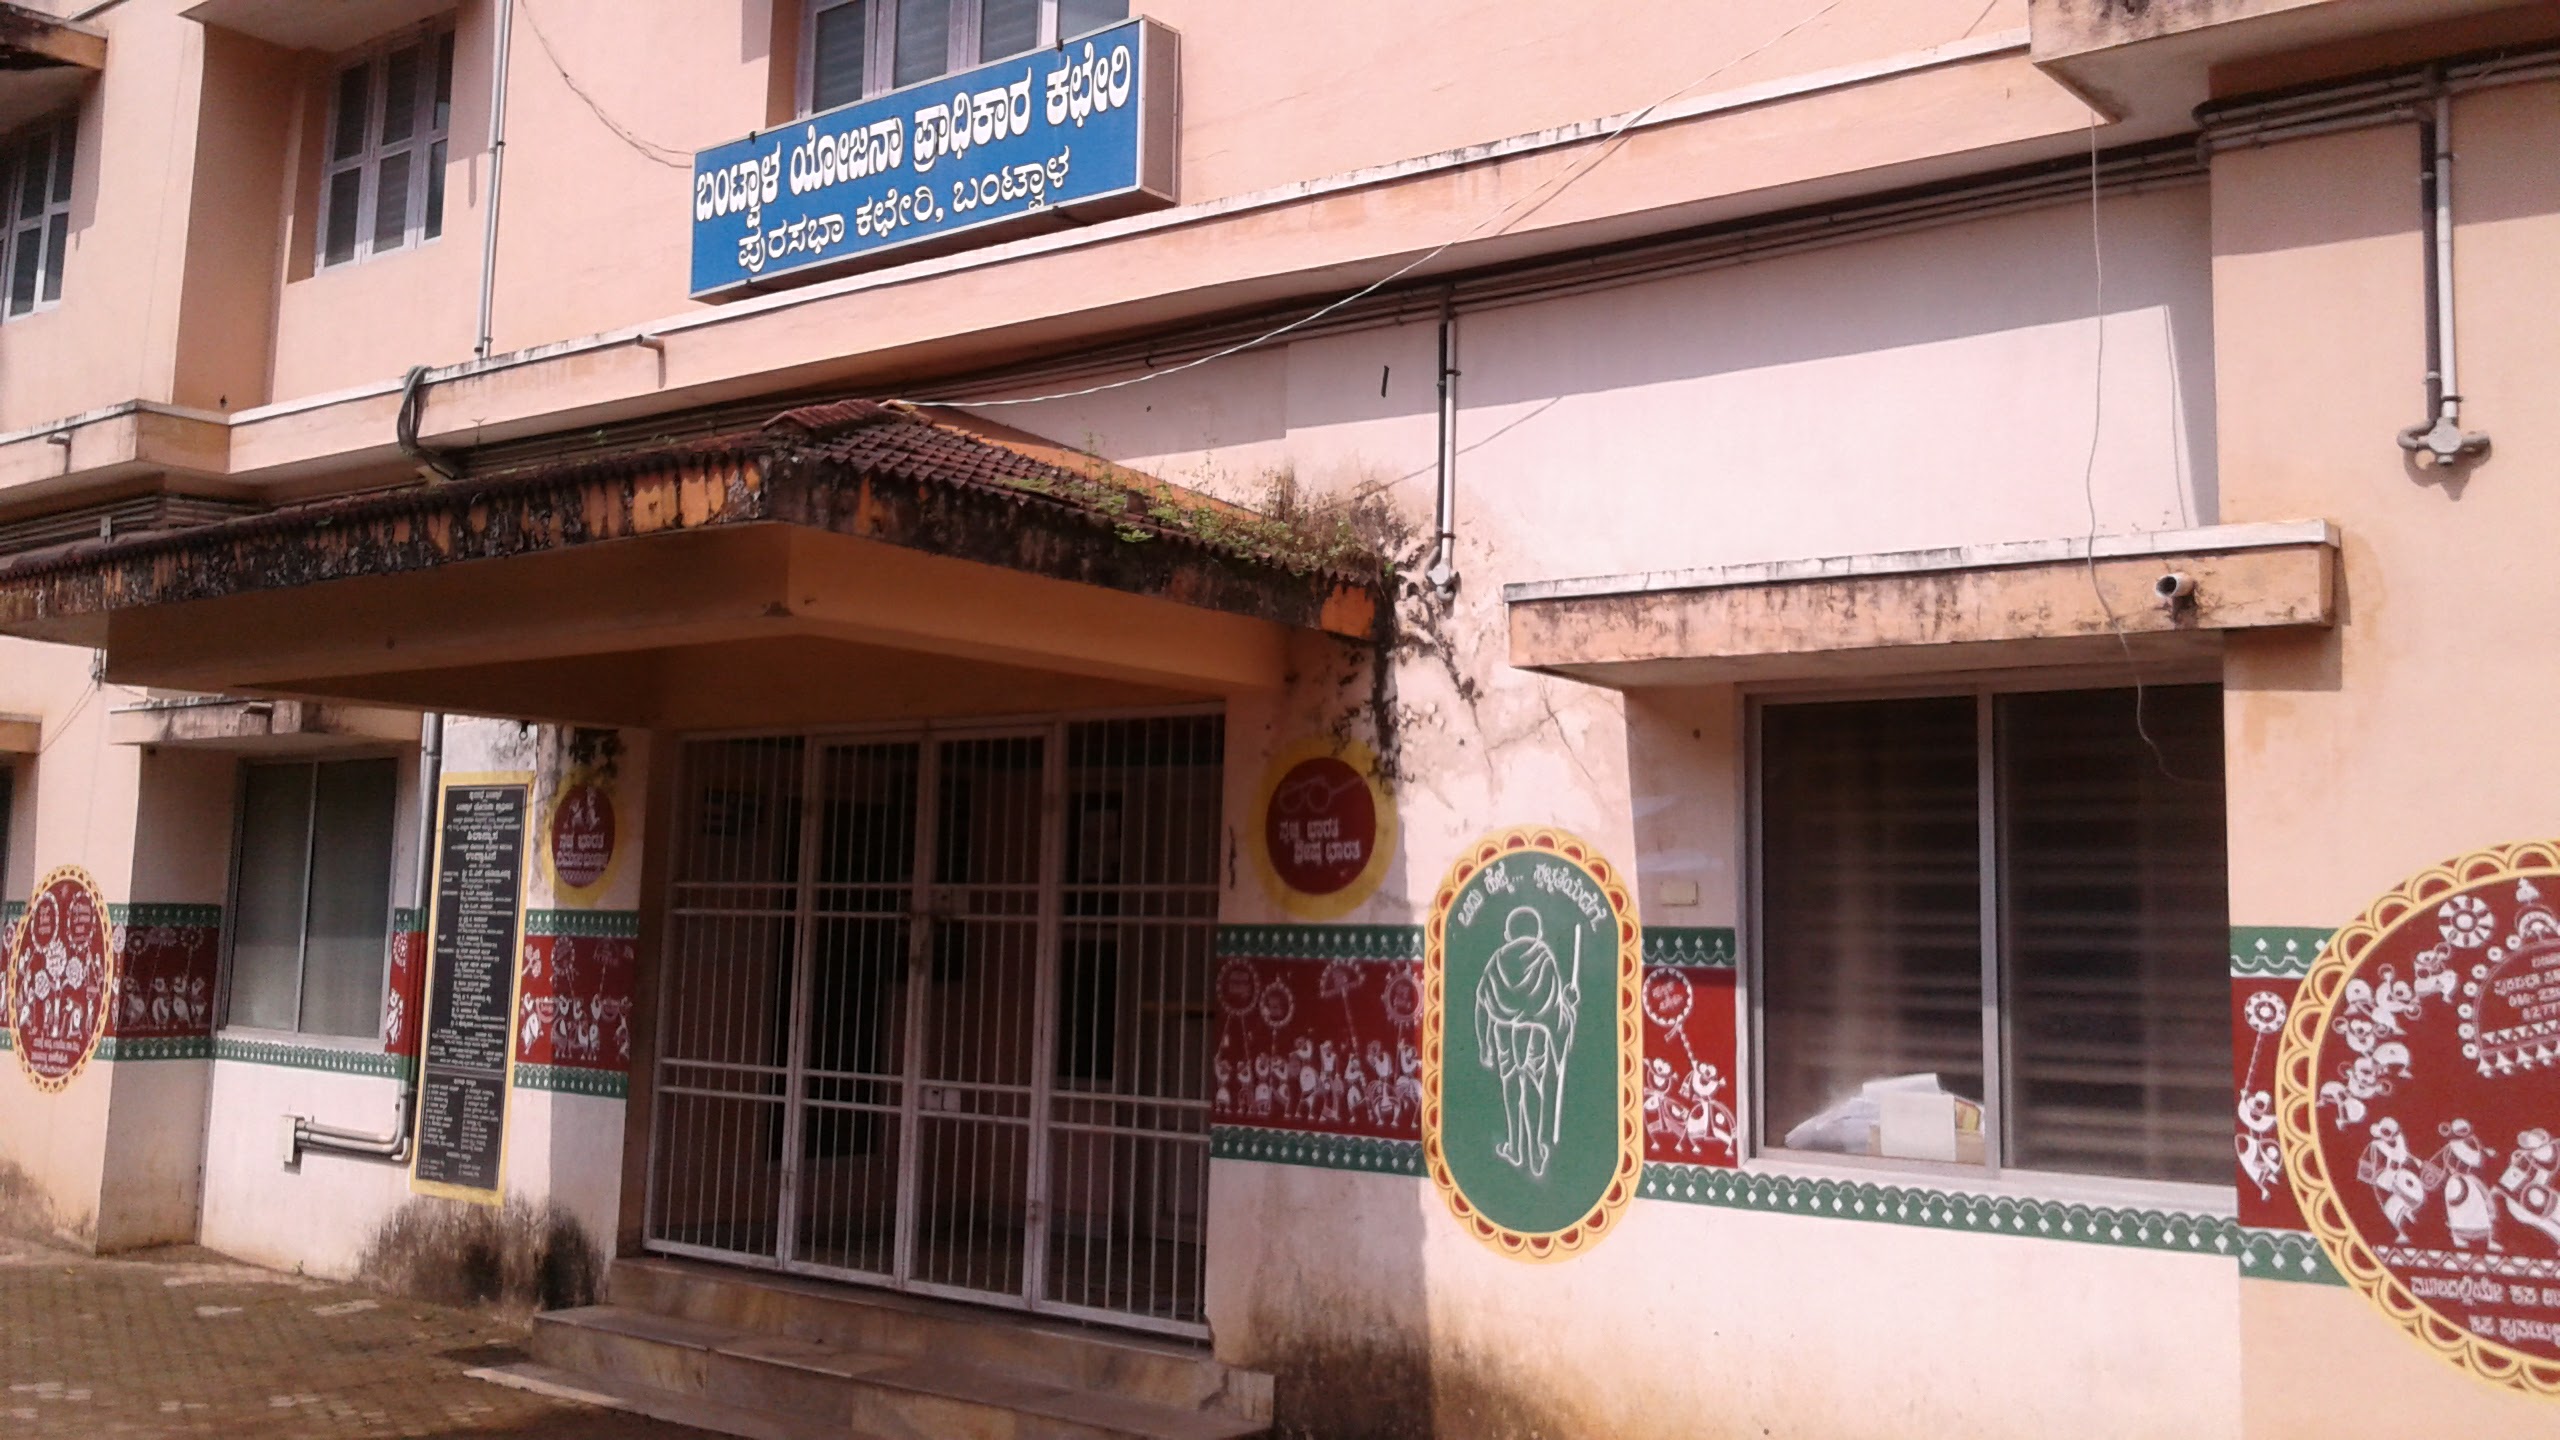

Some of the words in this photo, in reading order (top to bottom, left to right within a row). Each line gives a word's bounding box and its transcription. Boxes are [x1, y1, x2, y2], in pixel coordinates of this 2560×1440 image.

[696, 141, 781, 228] ಬಂಟ್ವಾಳ
[790, 116, 904, 196] ಯೋಜನಾ
[912, 67, 1032, 173] ಪ್ರಾಧಿಕಾರ
[1045, 41, 1131, 128] ಕಛೇರಿ
[738, 213, 845, 273] ಪುರಸಭಾ
[856, 186, 944, 238] ಕಛೇರಿ,
[952, 145, 1070, 213] ಬಂಟ್ವಾಳ
[1457, 888, 1484, 927] ಒಂದು
